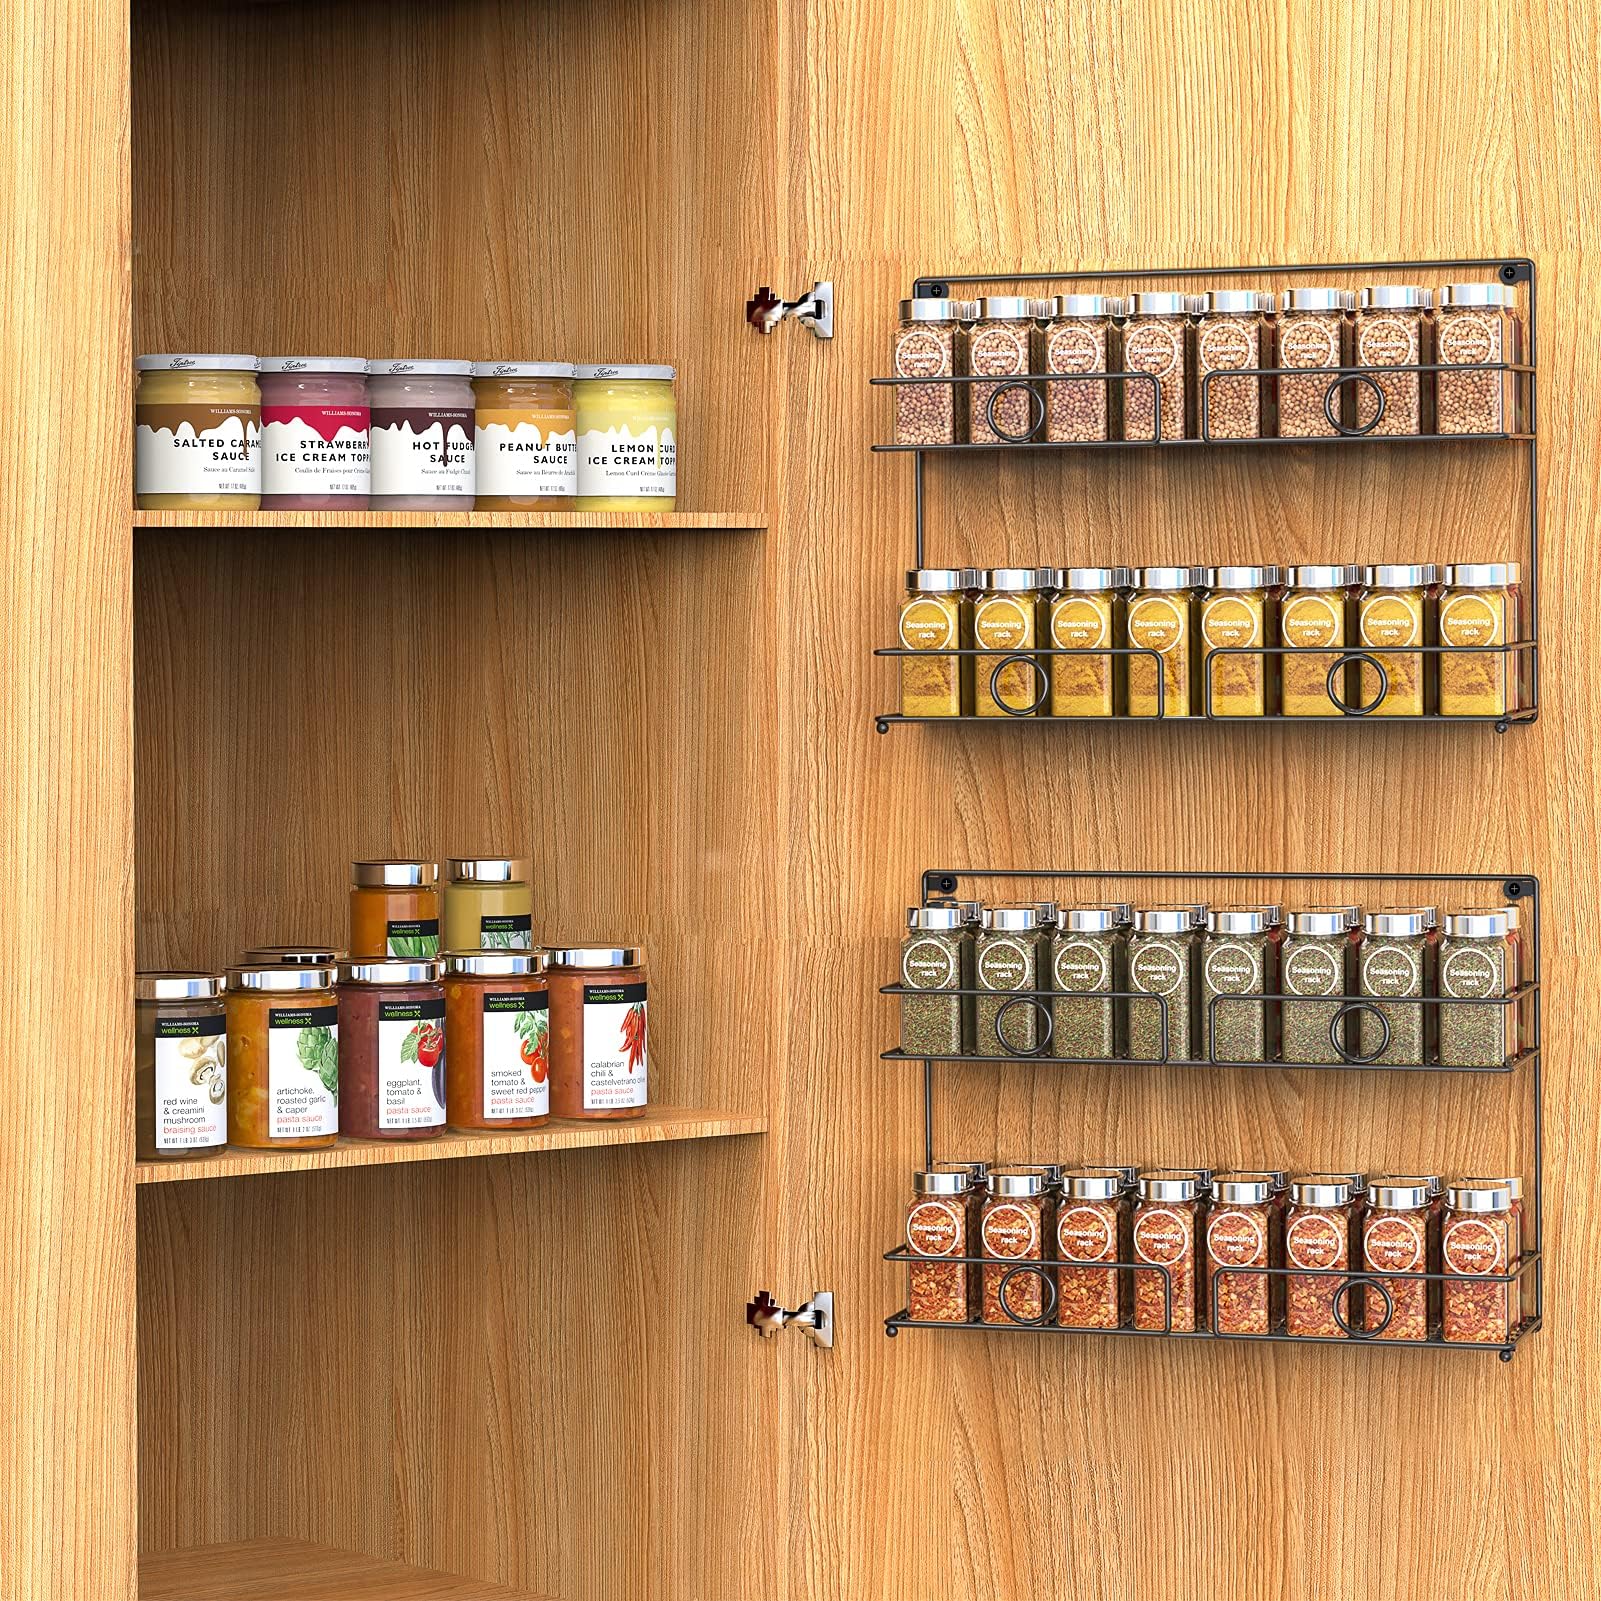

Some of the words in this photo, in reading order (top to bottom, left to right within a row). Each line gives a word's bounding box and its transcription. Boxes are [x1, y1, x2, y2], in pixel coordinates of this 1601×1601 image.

[1447, 339, 1487, 347] Seasoning
[1208, 345, 1246, 353] Seasoning
[174, 439, 224, 448] SALTED
[413, 442, 440, 450] HOT
[446, 442, 474, 451] FUDGE
[500, 444, 551, 452] PEANUT
[612, 444, 654, 453] LEMON
[213, 452, 250, 460] SAUCE
[276, 453, 296, 462] ICE
[303, 453, 346, 462] CREAM
[430, 454, 466, 463] SAUCE
[534, 456, 568, 464] SAUCE
[588, 457, 608, 465] ICE
[614, 457, 654, 465] CREAM
[906, 621, 946, 630] Seasoning
[982, 620, 1021, 629] Seasoning
[1058, 620, 1098, 628] Seasoning
[1134, 620, 1175, 628] Seasoning
[1208, 620, 1250, 628] Seasoning
[1290, 619, 1331, 628] Seasoning
[1368, 618, 1410, 626] Seasoning
[1448, 618, 1490, 626] Seasoning
[1381, 628, 1398, 636] rack
[1461, 628, 1479, 636] rack
[910, 961, 947, 969] Seasoning
[985, 962, 1022, 970] Seasoning
[1062, 963, 1099, 972] Seasoning
[1139, 964, 1176, 972] Seasoning
[1212, 966, 1250, 974] Seasoning
[1292, 966, 1331, 976] Seasoning
[1370, 968, 1410, 977] Seasoning
[1450, 969, 1490, 978] Seasoning
[489, 1001, 518, 1009] wellness
[591, 1061, 624, 1069] calabrian
[387, 1079, 422, 1088] eggplant,
[492, 1078, 518, 1086] tomato
[491, 1088, 514, 1096] sweet
[516, 1086, 528, 1095] red
[591, 1087, 612, 1096] pasta
[277, 1096, 307, 1105] roasted
[310, 1096, 326, 1106] garlic
[492, 1097, 512, 1105] pasta
[516, 1096, 534, 1104] sauce
[164, 1107, 170, 1115] &
[172, 1106, 206, 1115] creamini
[277, 1106, 284, 1114] &
[286, 1106, 308, 1115] caper
[387, 1107, 409, 1115] pasta
[164, 1116, 206, 1125] mushroom
[277, 1116, 300, 1125] pasta
[302, 1114, 322, 1122] sauce
[164, 1125, 196, 1135] braising
[198, 1124, 216, 1132] sauce
[912, 1224, 952, 1233] Seasoning
[988, 1226, 1028, 1235] Seasoning
[1064, 1228, 1104, 1238] Seasoning
[1141, 1232, 1180, 1240] Seasoning
[1214, 1234, 1254, 1242] Seasoning
[1294, 1236, 1334, 1246] Seasoning
[1372, 1239, 1412, 1248] Seasoning
[1226, 1244, 1244, 1252] rack
[1306, 1246, 1324, 1254] rack
[1450, 1242, 1491, 1252] Seasoning
[1384, 1250, 1402, 1258] rack
[1464, 1252, 1480, 1260] rack
